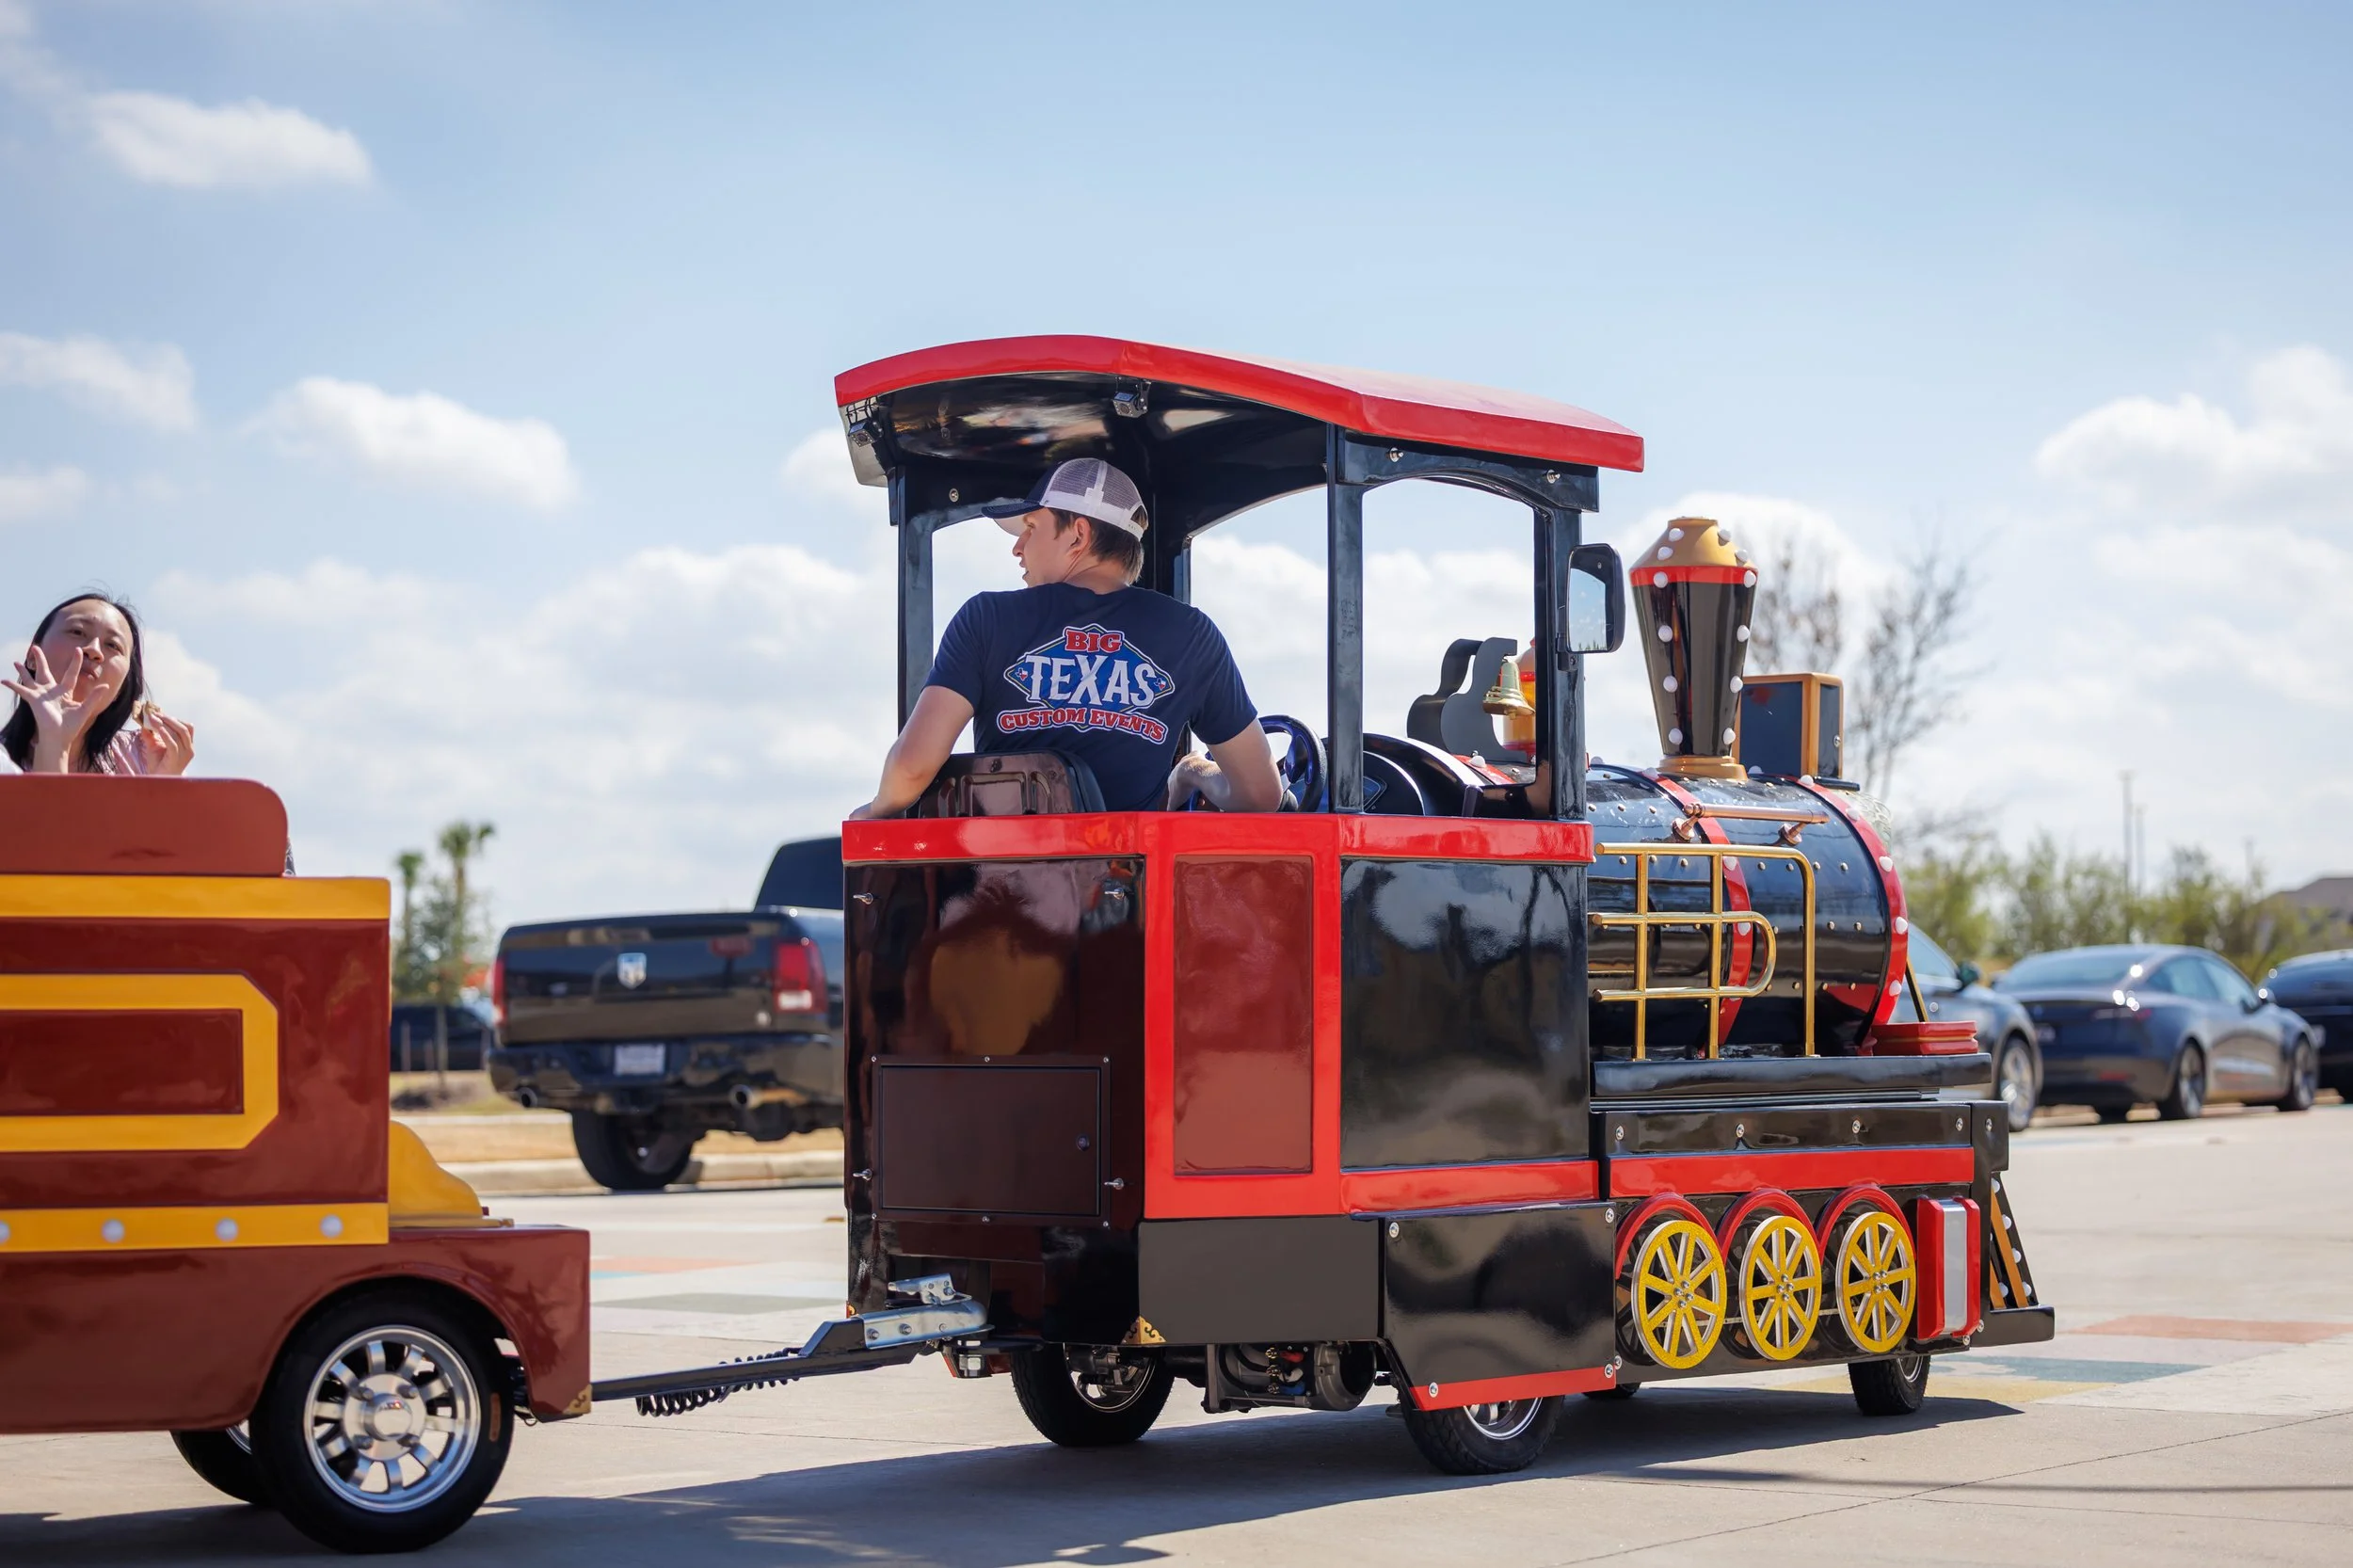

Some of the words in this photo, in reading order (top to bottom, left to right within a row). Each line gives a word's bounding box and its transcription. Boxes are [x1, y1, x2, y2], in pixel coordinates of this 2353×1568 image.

[1064, 630, 1122, 653] BIG
[1024, 654, 1157, 706] TEXAS
[1000, 708, 1086, 730] CUSTOM
[1089, 709, 1166, 742] EVENTS
